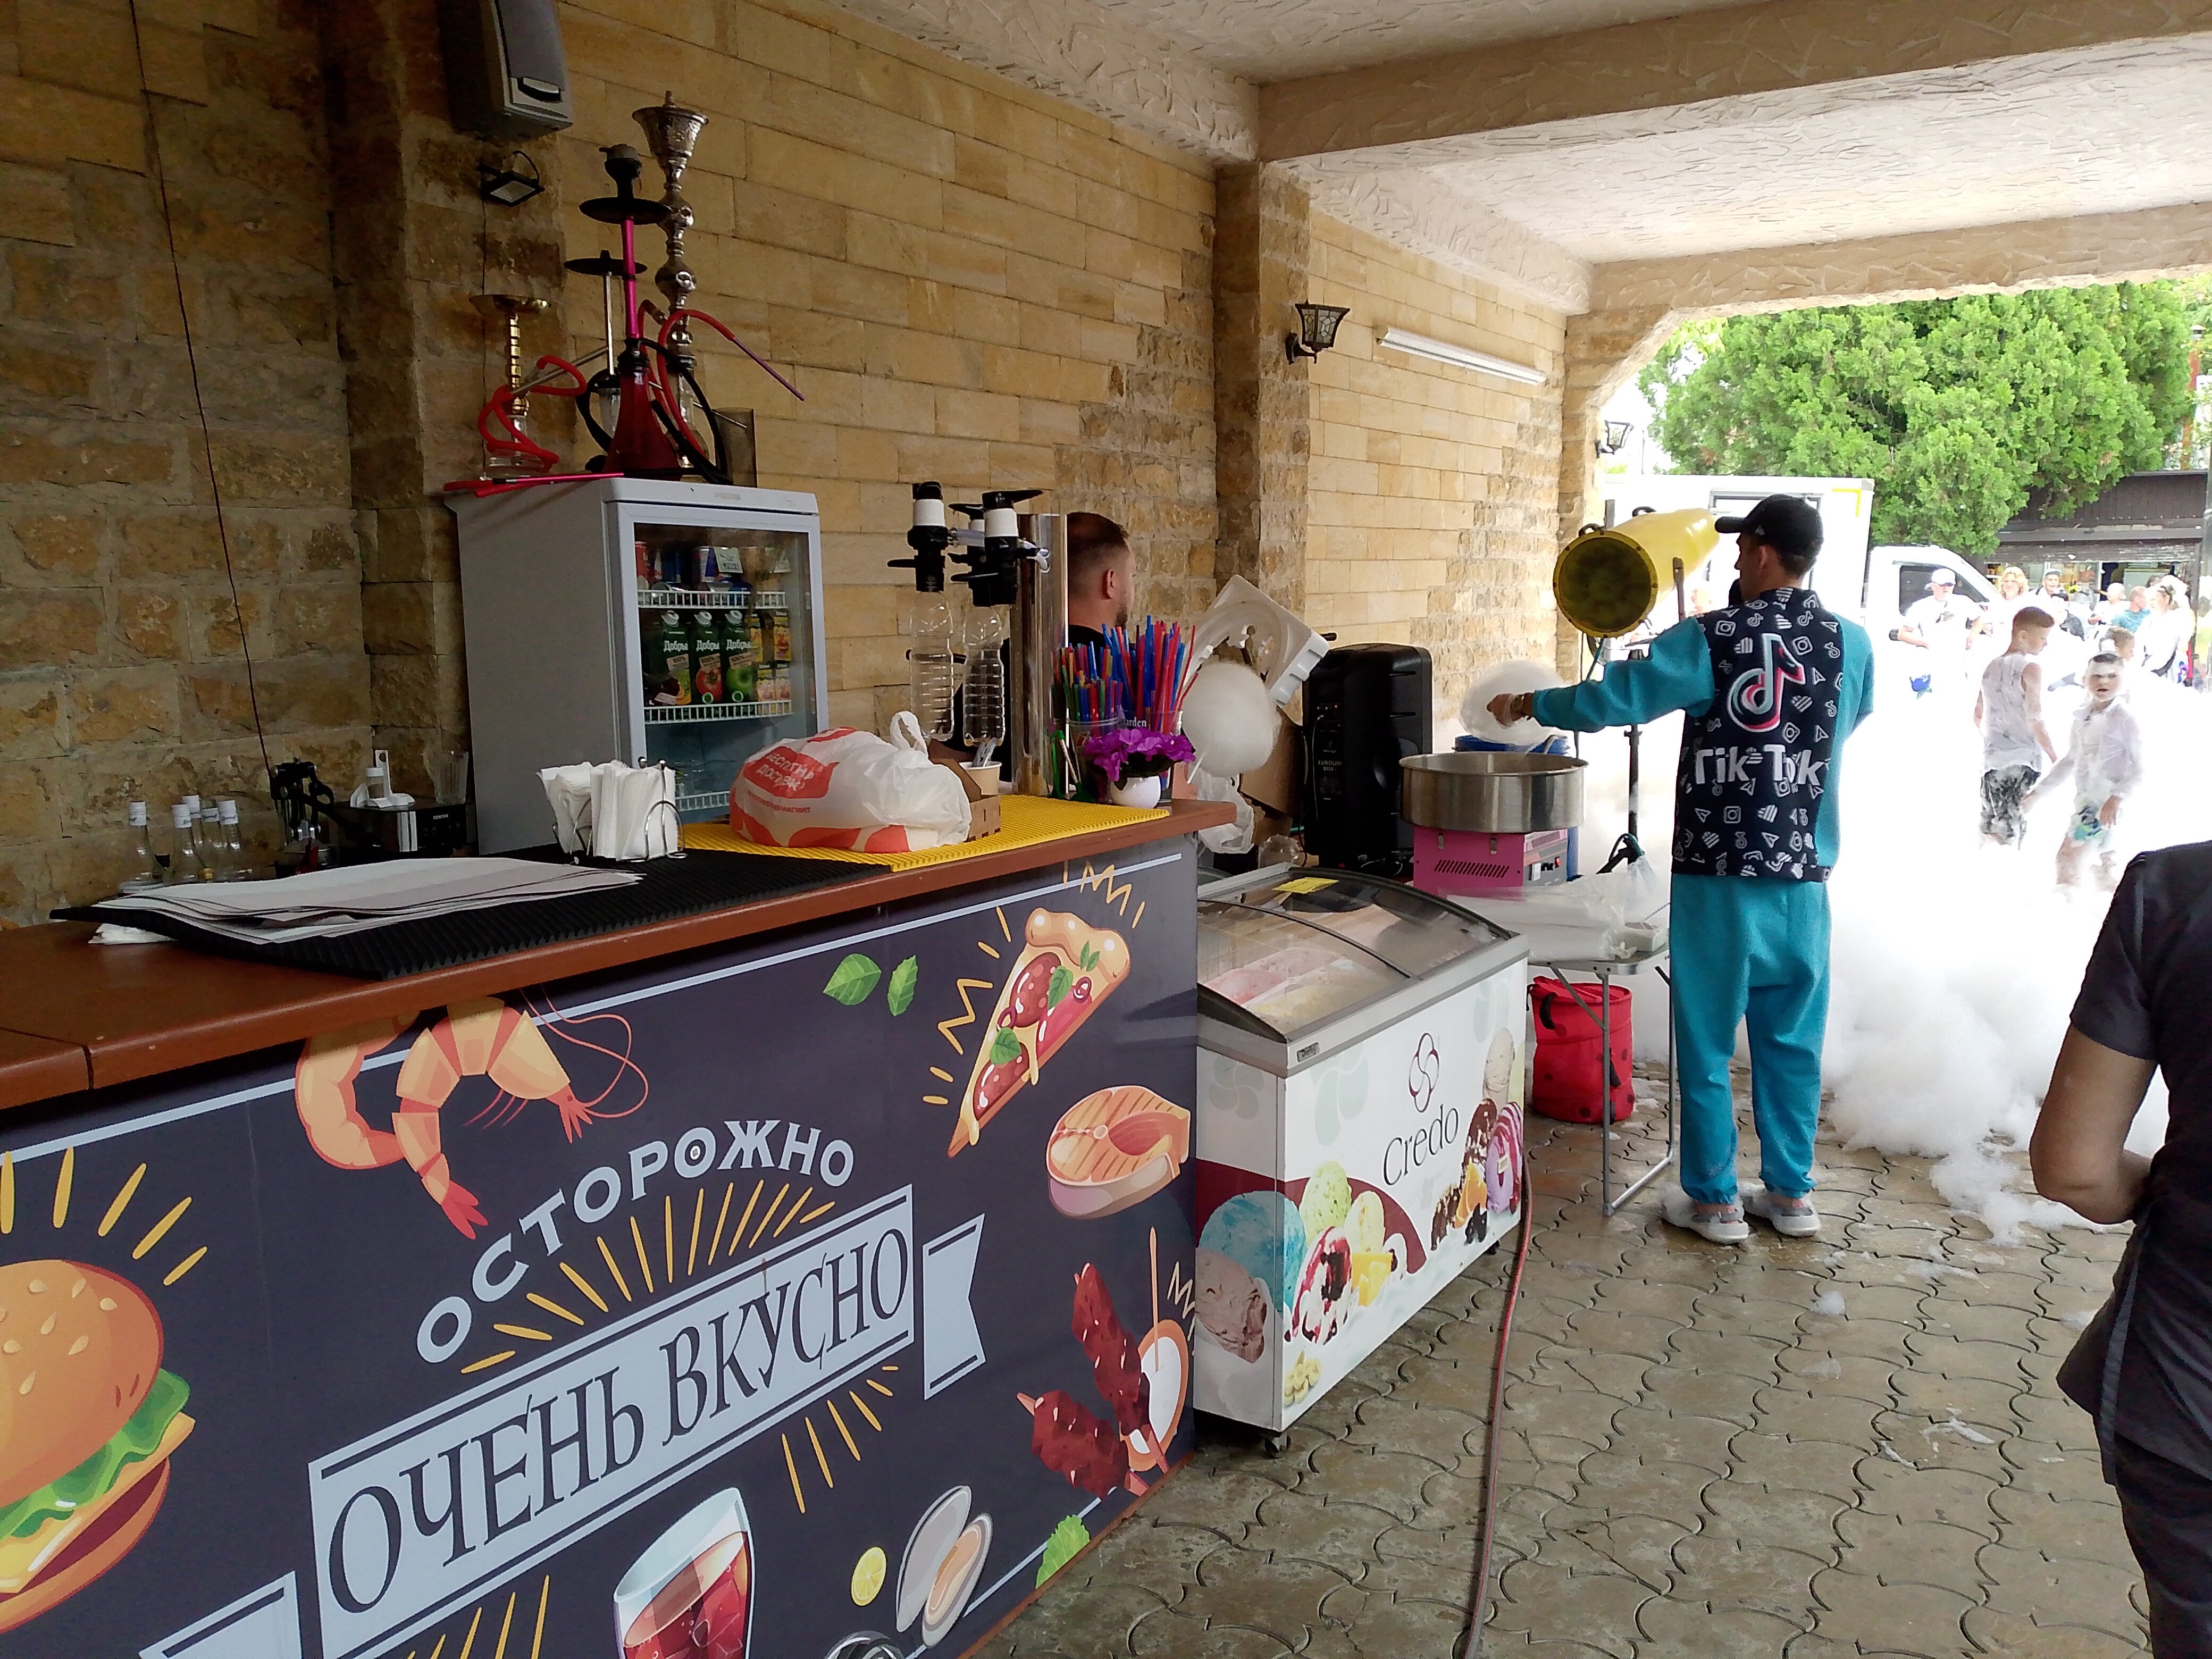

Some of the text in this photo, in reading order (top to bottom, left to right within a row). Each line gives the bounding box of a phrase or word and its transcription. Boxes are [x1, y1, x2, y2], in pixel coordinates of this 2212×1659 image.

[417, 1119, 854, 1363] ОСТОРОЖНО
[1384, 1103, 1459, 1186] Credo
[328, 1227, 909, 1614] ОЧЕНЬ ВКУСНО
